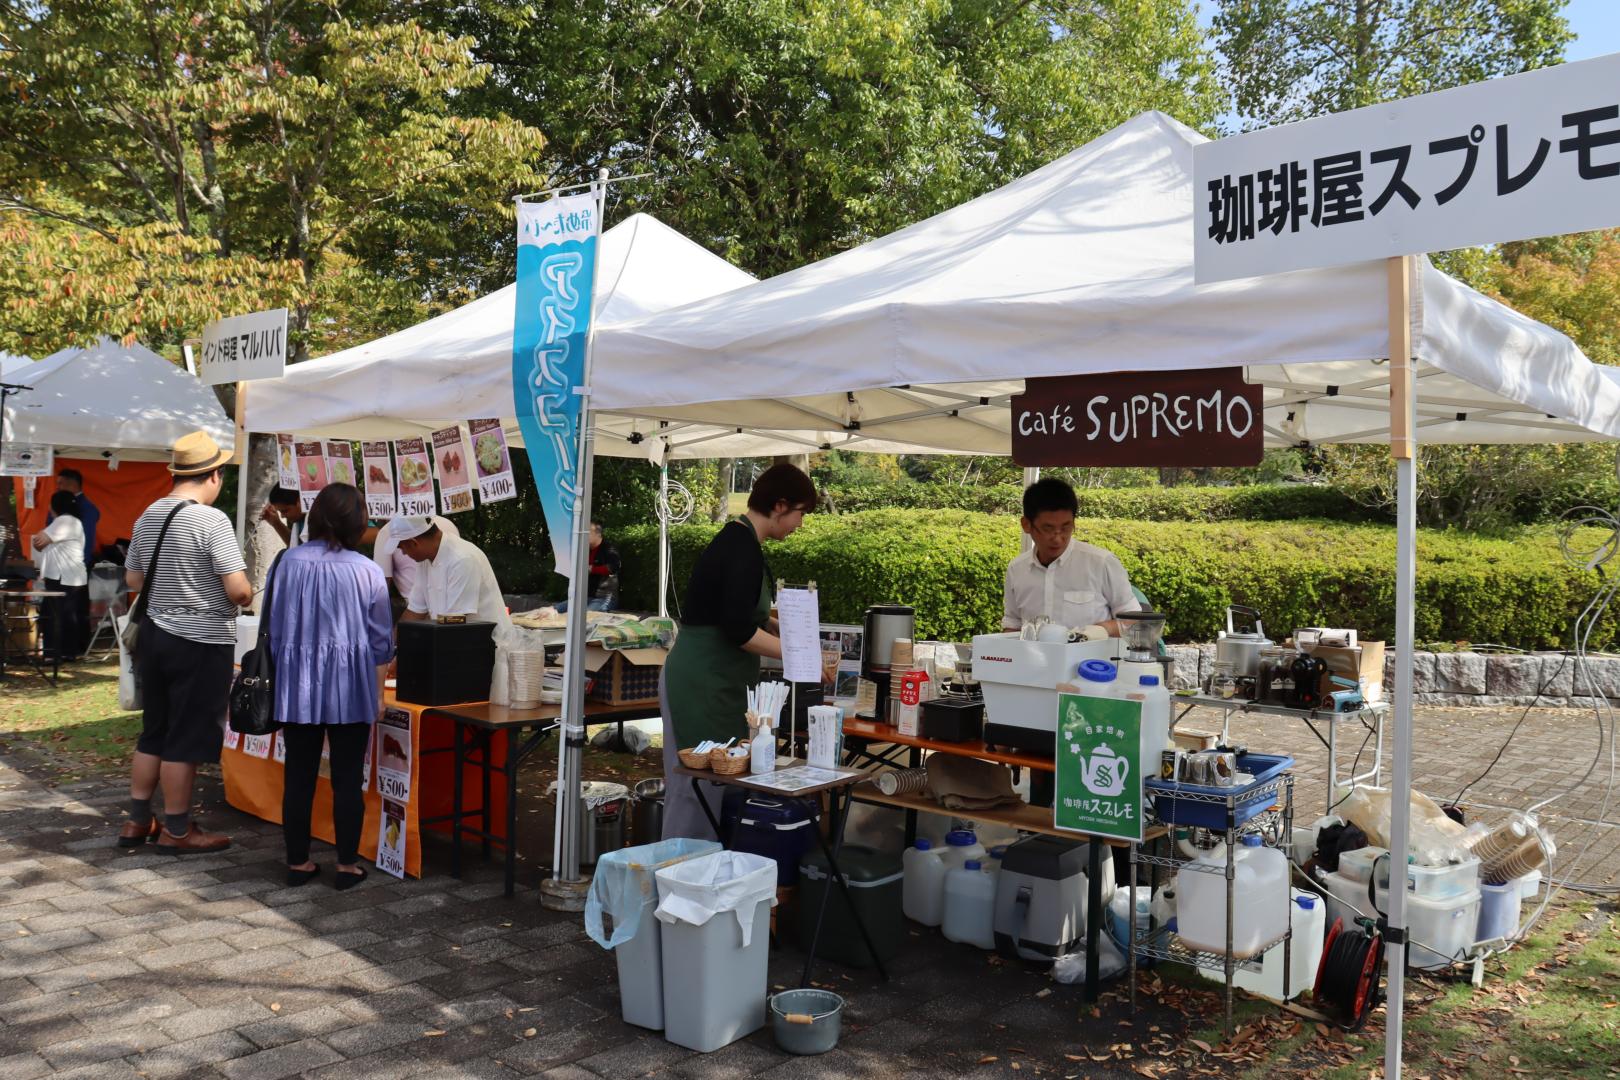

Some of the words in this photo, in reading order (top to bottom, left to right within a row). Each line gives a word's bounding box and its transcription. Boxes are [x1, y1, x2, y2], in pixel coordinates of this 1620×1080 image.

[1207, 103, 1620, 246] 珈琲屋スプレモ
[204, 335, 238, 364] インド料理
[240, 325, 282, 361] マルハバ
[1086, 389, 1253, 443] SUPREMO
[1063, 797, 1135, 820] 珈琲屋スプレモ
